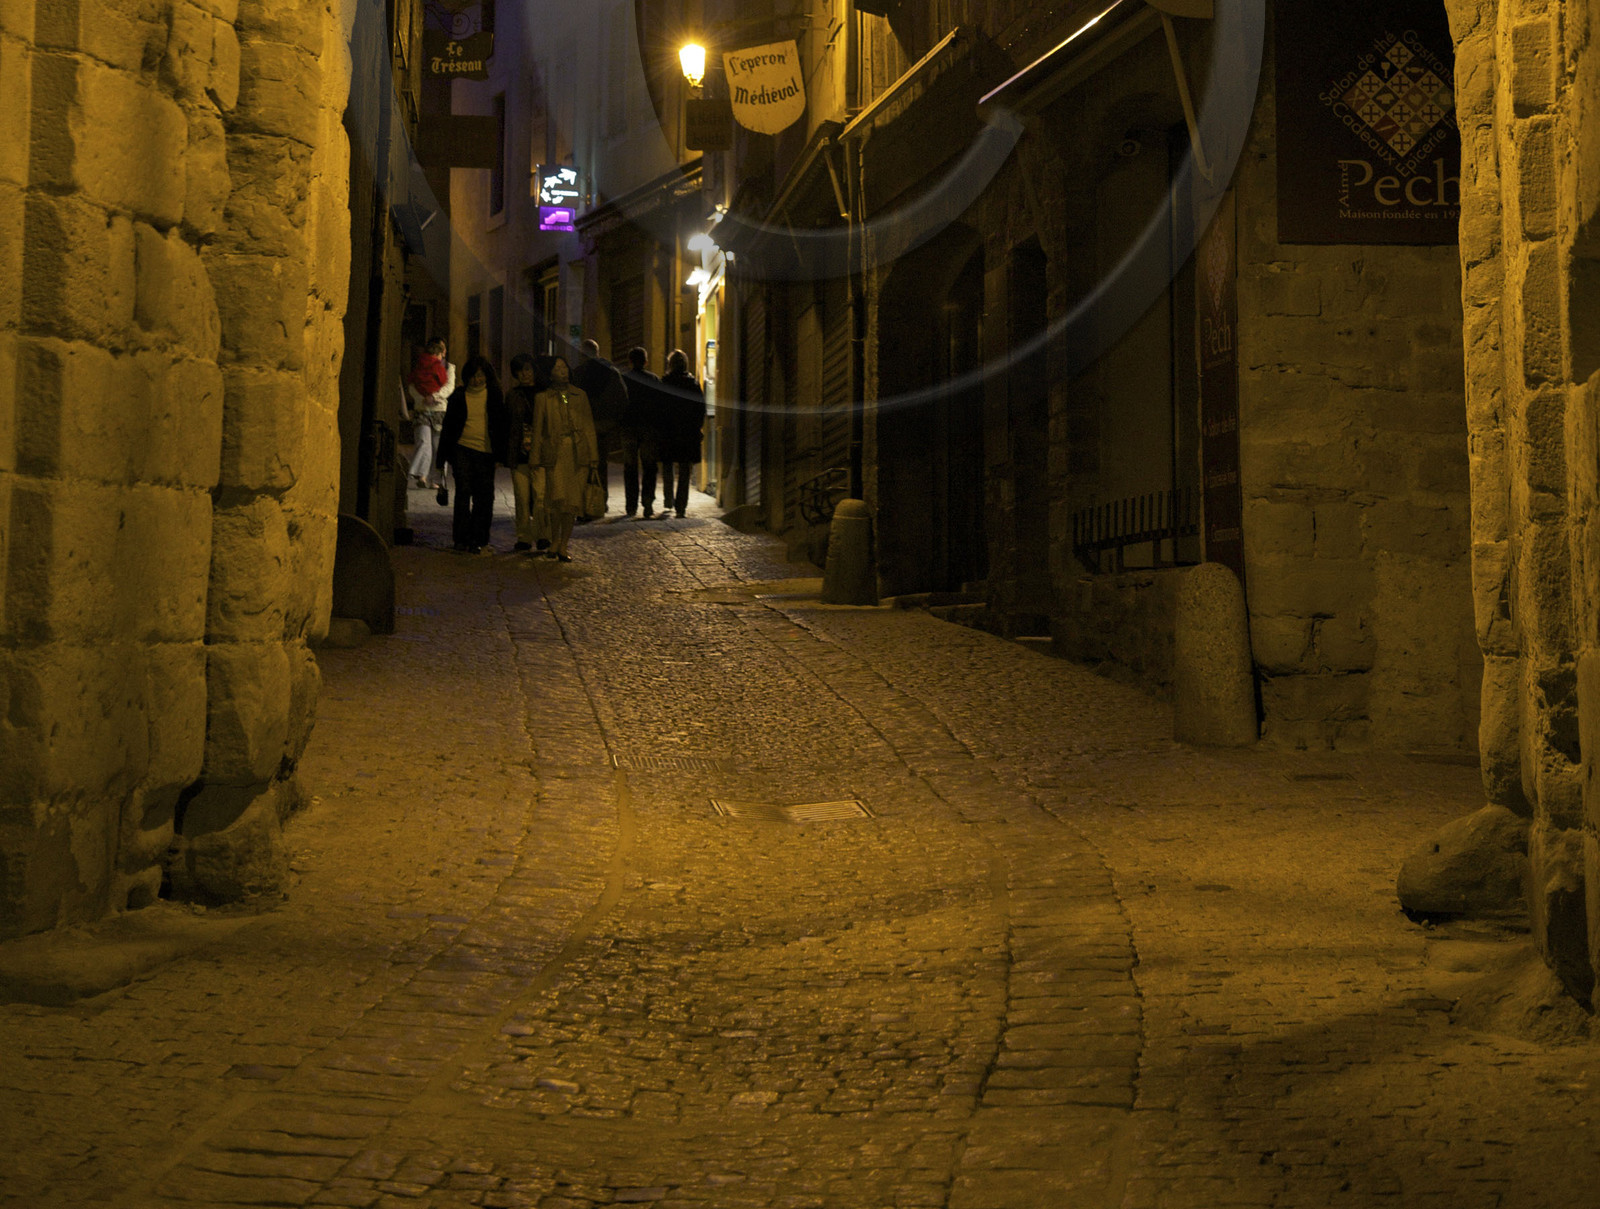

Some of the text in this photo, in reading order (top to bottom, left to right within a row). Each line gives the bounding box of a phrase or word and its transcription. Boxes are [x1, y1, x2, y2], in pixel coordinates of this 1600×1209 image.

[445, 41, 463, 57] Le
[1319, 29, 1397, 106] Salon de thé
[1333, 102, 1396, 166] Cadeaux
[1395, 129, 1447, 178] Epicerie
[1339, 209, 1381, 220] Maison
[1382, 209, 1421, 220] fondée
[1424, 211, 1439, 220] en
